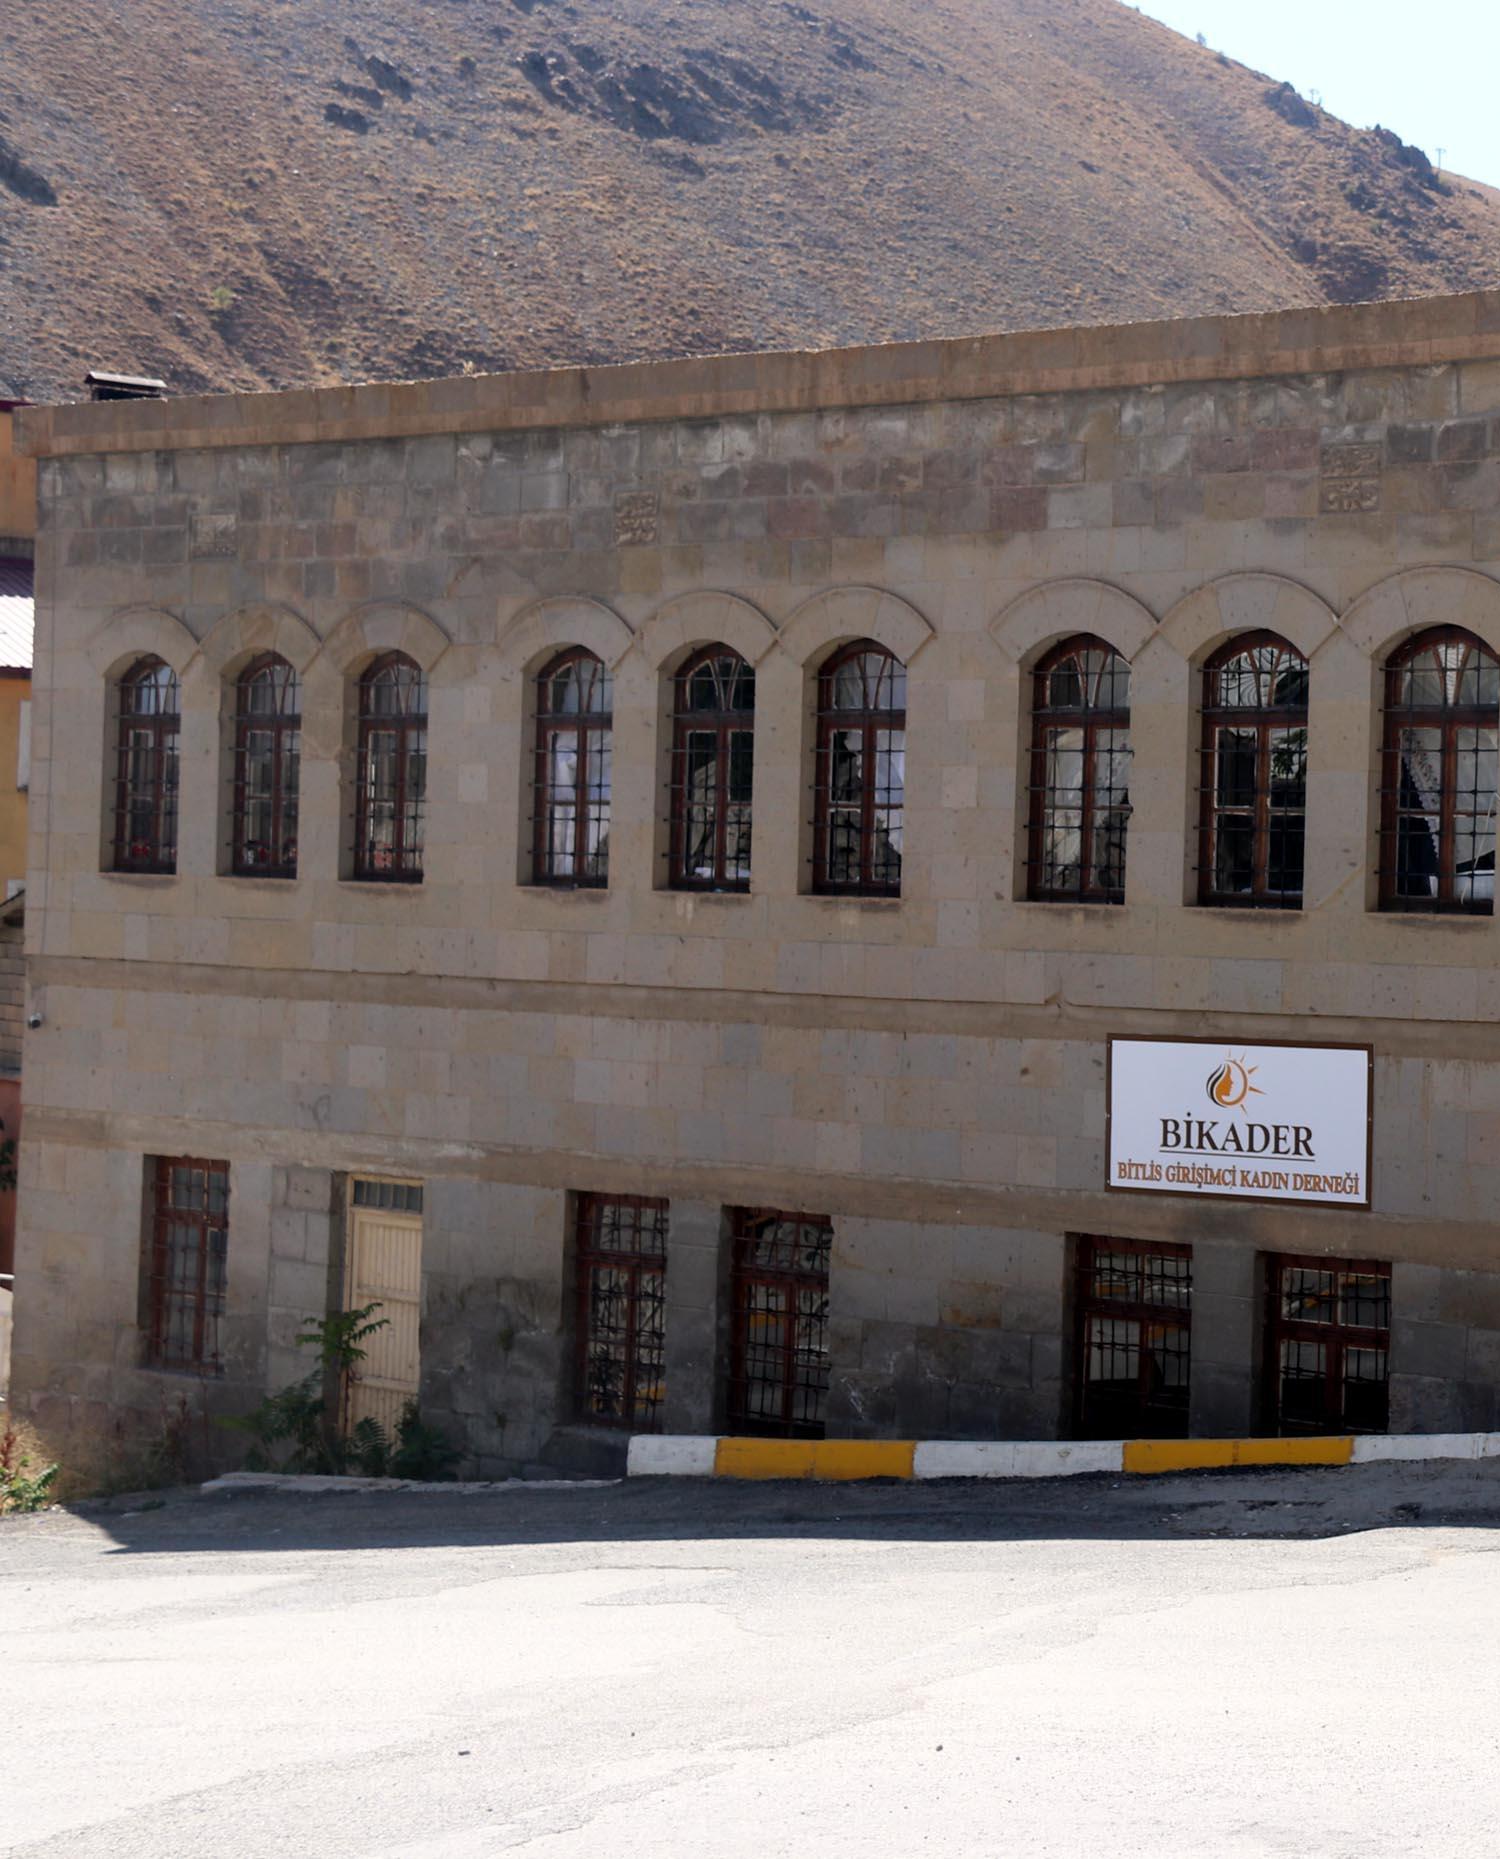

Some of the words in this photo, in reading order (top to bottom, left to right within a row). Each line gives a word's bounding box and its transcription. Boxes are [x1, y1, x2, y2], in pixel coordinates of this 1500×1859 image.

[1160, 1112, 1315, 1156] BİKADER
[1118, 1158, 1162, 1181] BİTLİS
[1240, 1169, 1288, 1190] KADIN
[1293, 1171, 1360, 1195] DERNEĞİ
